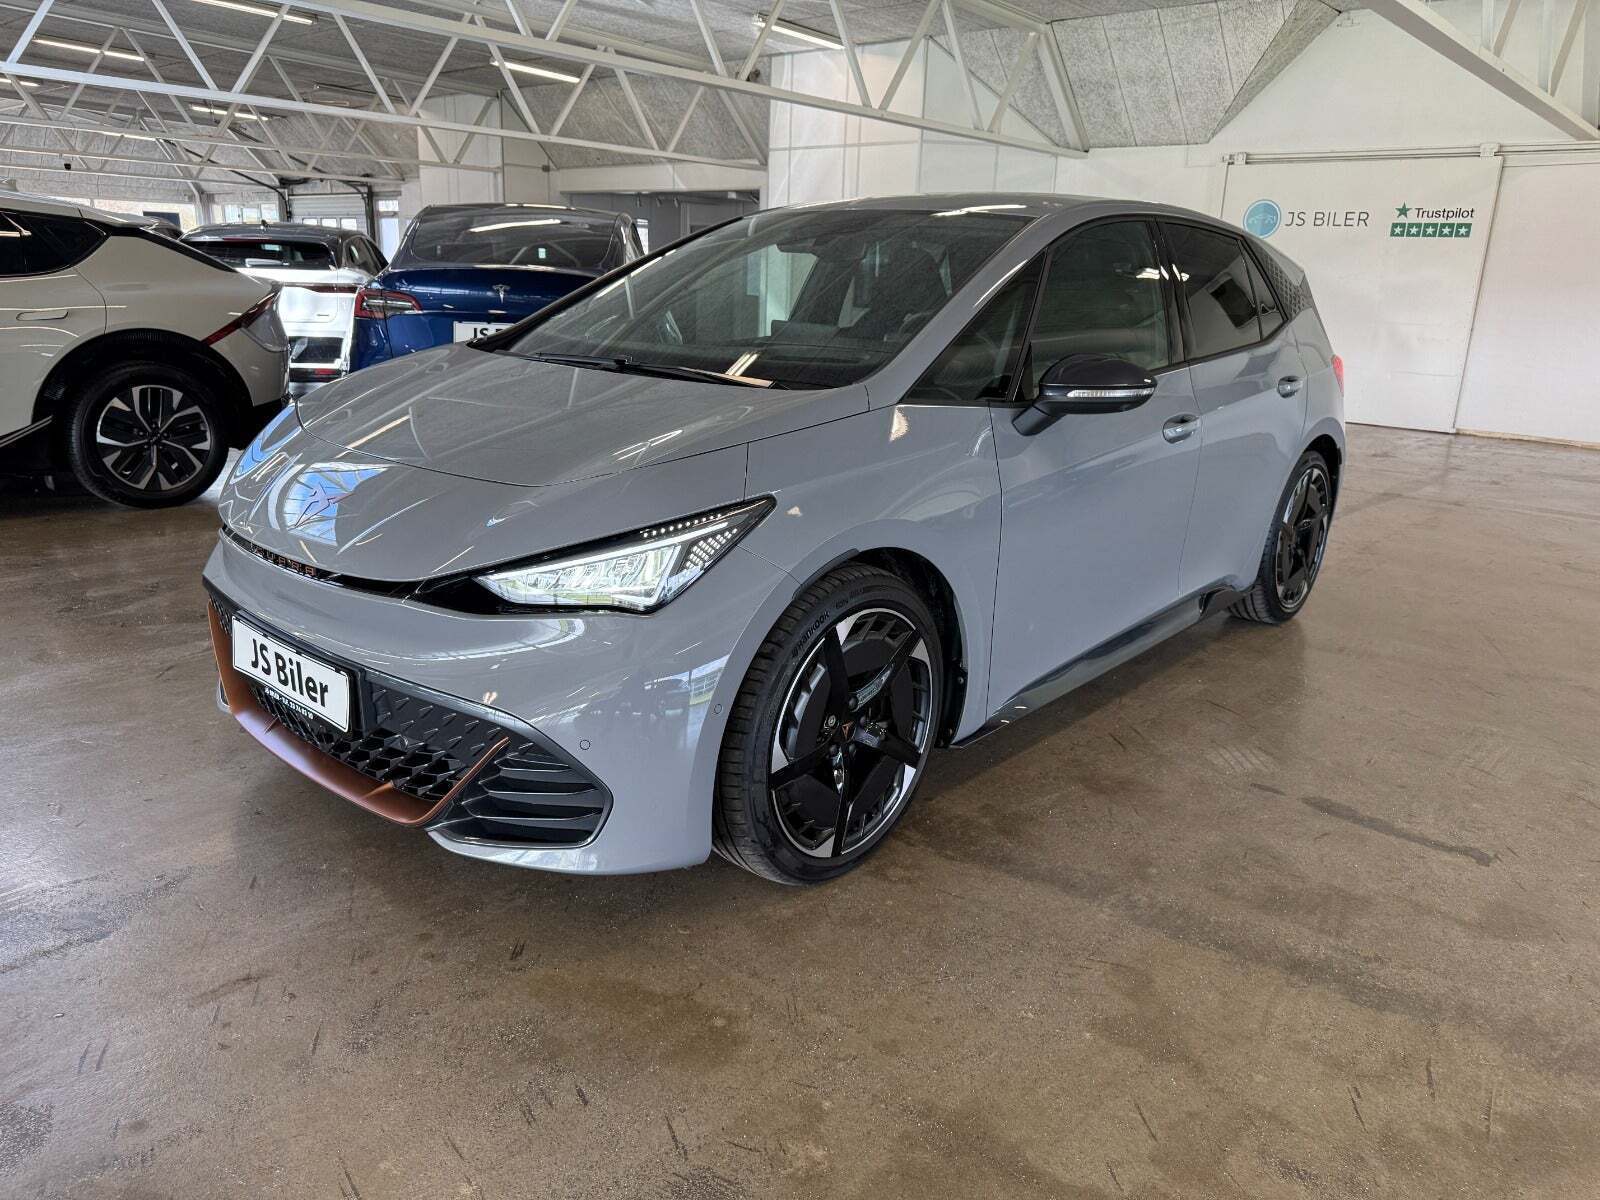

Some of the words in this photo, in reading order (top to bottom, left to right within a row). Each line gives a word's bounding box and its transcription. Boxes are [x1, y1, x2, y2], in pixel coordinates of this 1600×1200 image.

[1285, 211, 1306, 228] JS
[1313, 211, 1370, 228] BILER
[1414, 207, 1475, 221] Trustpilot
[250, 638, 272, 676] JS
[274, 651, 329, 708] Biler
